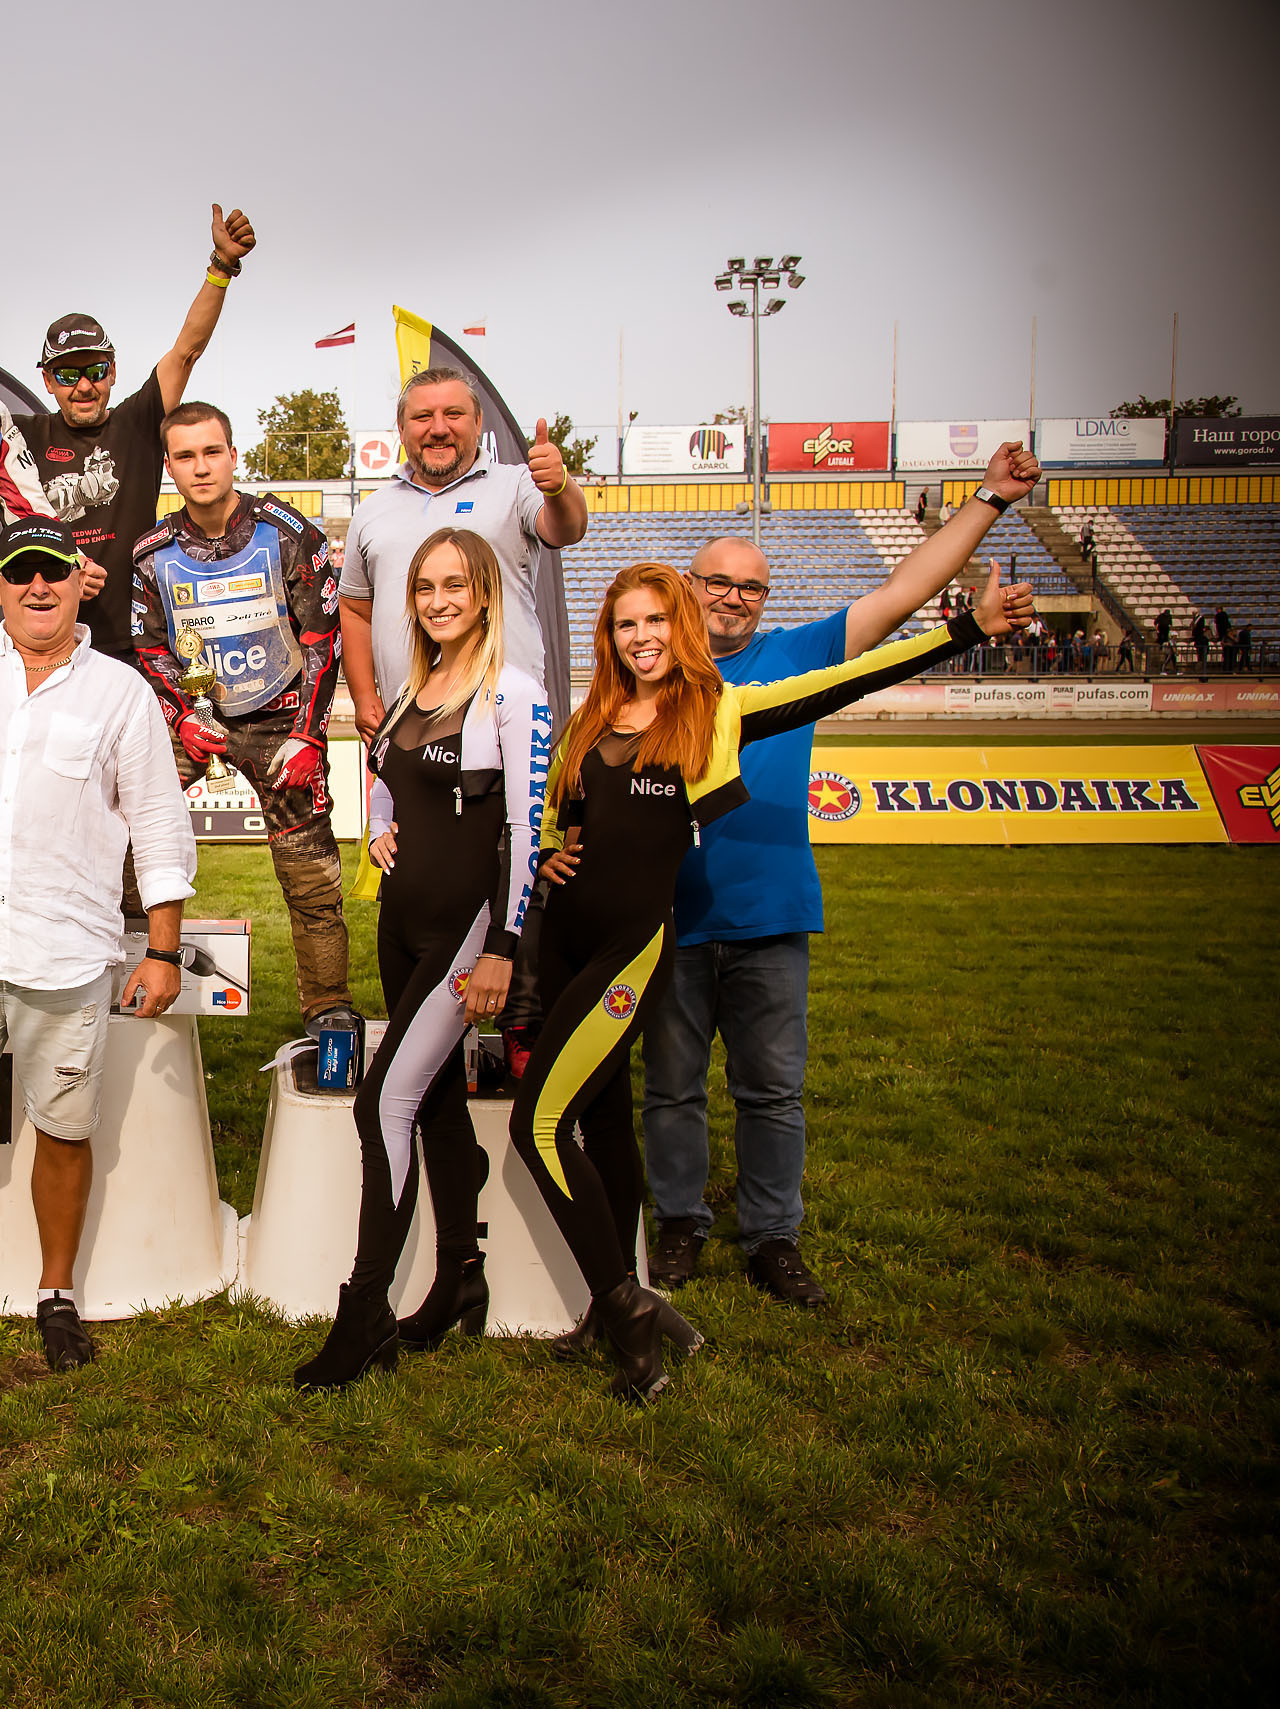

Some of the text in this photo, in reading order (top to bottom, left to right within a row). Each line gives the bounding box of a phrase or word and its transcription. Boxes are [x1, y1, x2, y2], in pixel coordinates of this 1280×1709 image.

[1192, 429, 1280, 445] Наш горо
[1214, 446, 1275, 456] www.gorod.lv
[691, 462, 730, 470] CAPAROL
[272, 508, 304, 532] BERNER
[974, 689, 1046, 703] pufas.com
[1077, 688, 1149, 702] pufas.com
[1162, 693, 1215, 702] UNIMAX
[1237, 692, 1279, 701] UNIMA
[199, 726, 225, 740] THOR
[422, 744, 461, 765] Nic
[272, 767, 290, 790] THOR
[630, 778, 676, 797] Nice
[870, 778, 1201, 813] KLONDAIKA
